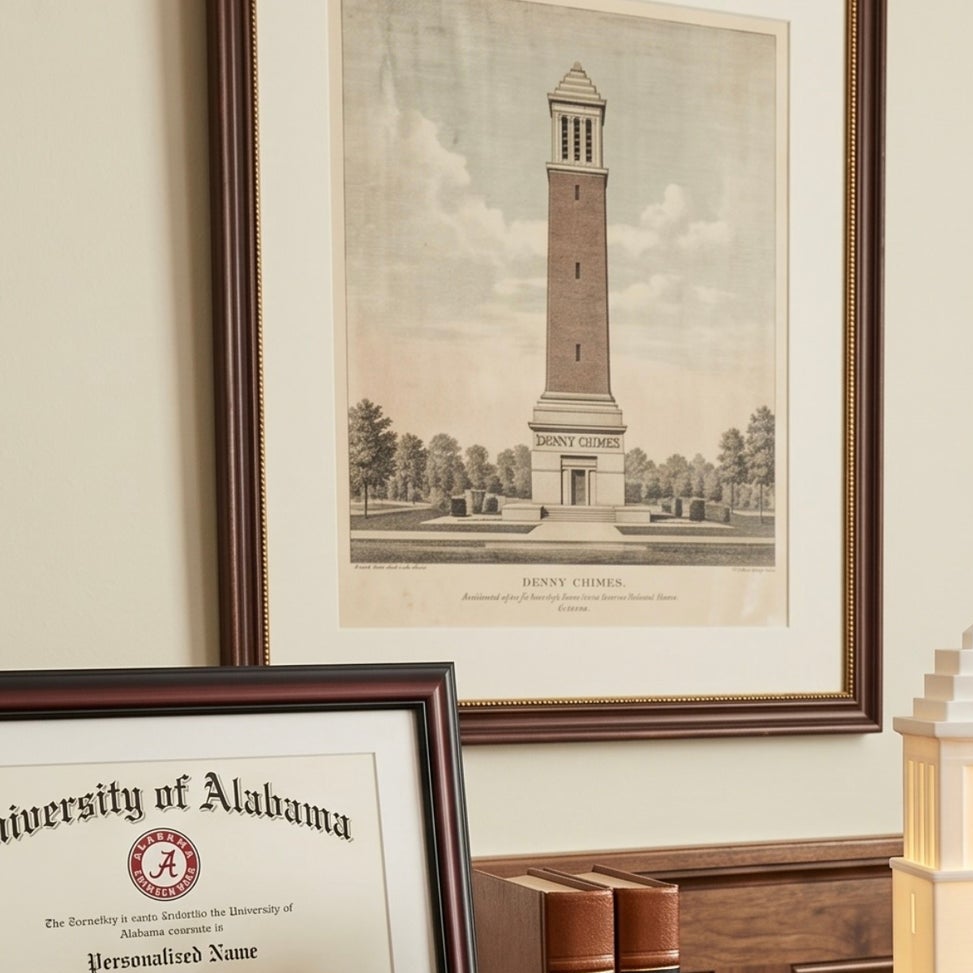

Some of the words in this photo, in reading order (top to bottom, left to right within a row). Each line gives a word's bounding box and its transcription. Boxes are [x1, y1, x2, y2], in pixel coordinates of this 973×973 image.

[578, 435, 621, 449] CHIMES
[522, 577, 568, 588] DENNY
[572, 577, 627, 589] CHIMES.
[154, 773, 191, 812] of
[199, 771, 354, 842] Alabama
[210, 908, 226, 918] the
[229, 904, 281, 917] University
[283, 903, 294, 913] of
[119, 928, 165, 939] Alabama
[208, 944, 259, 963] Name
